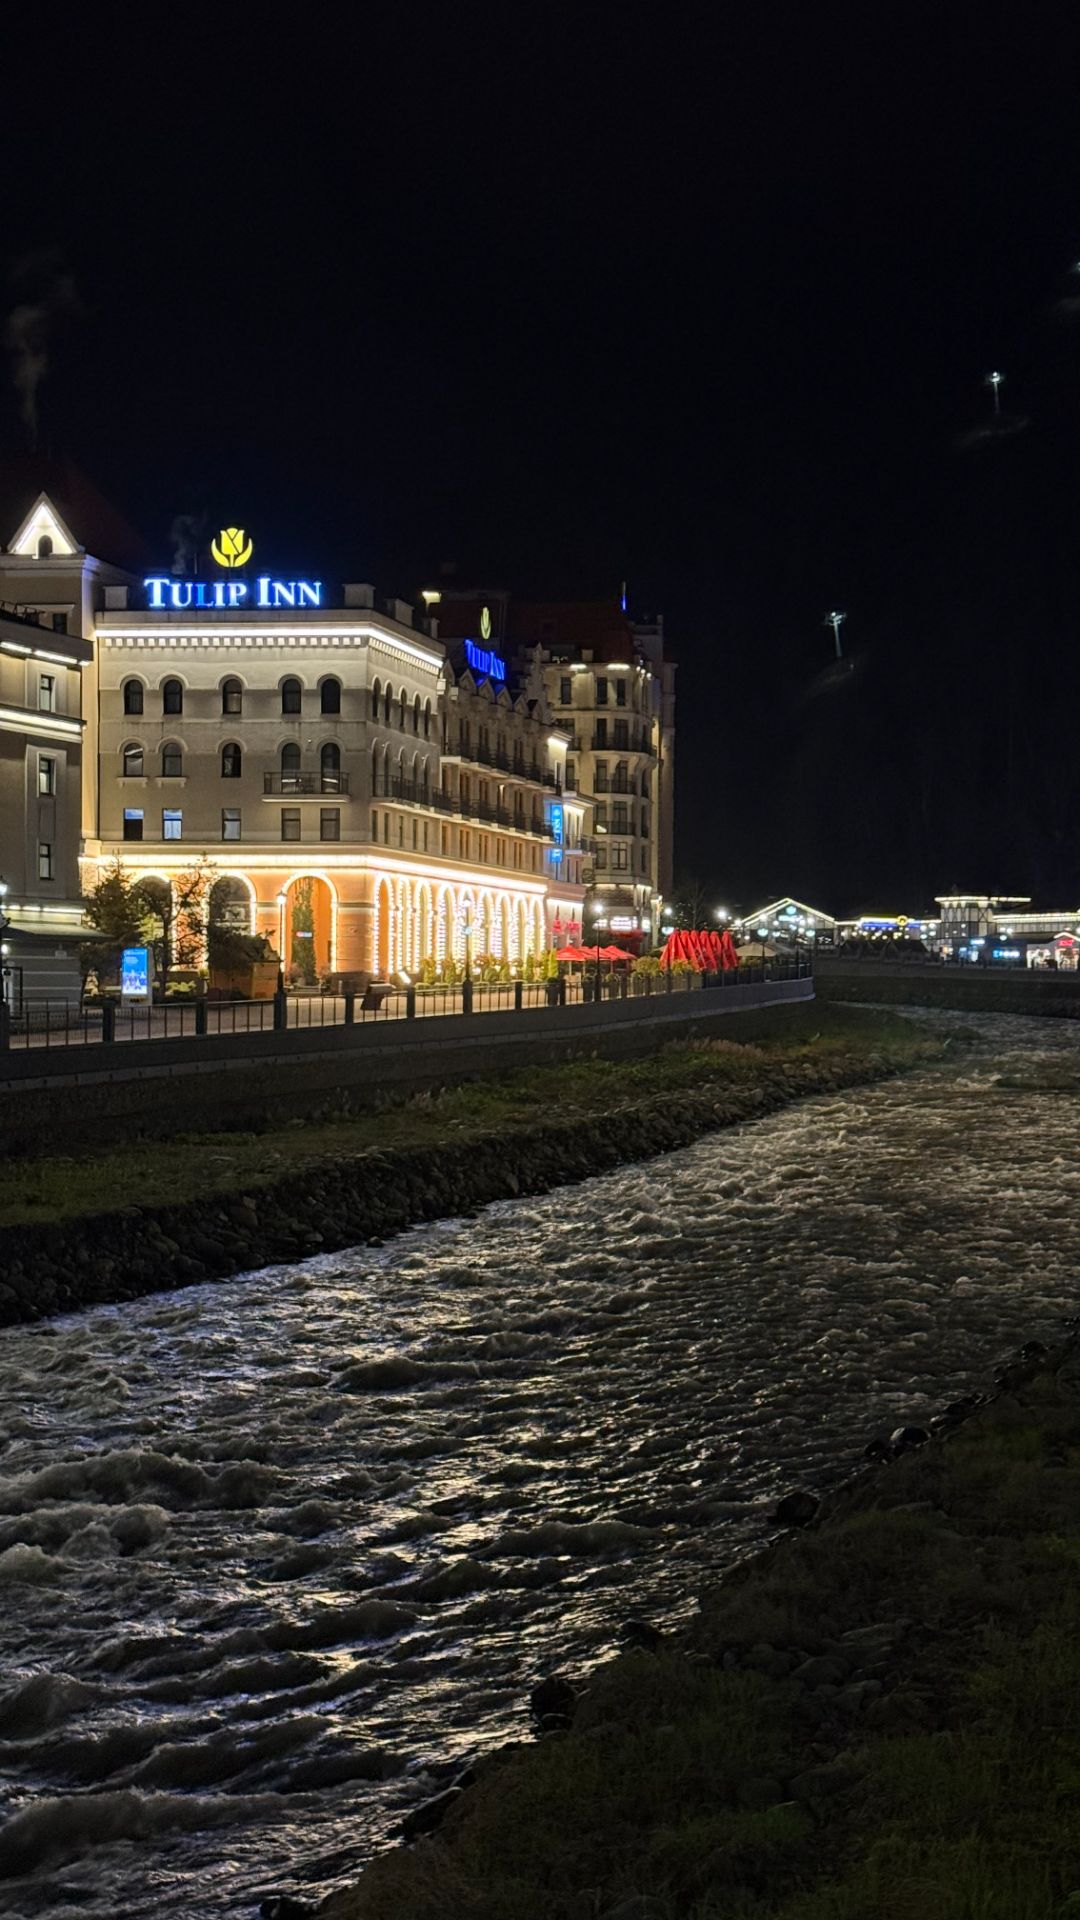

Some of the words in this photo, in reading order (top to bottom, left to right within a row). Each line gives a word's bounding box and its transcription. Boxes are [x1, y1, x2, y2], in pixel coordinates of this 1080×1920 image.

[144, 577, 247, 607] TULIP
[257, 576, 322, 606] INN
[465, 639, 490, 673] TULIP
[489, 651, 505, 681] INN
